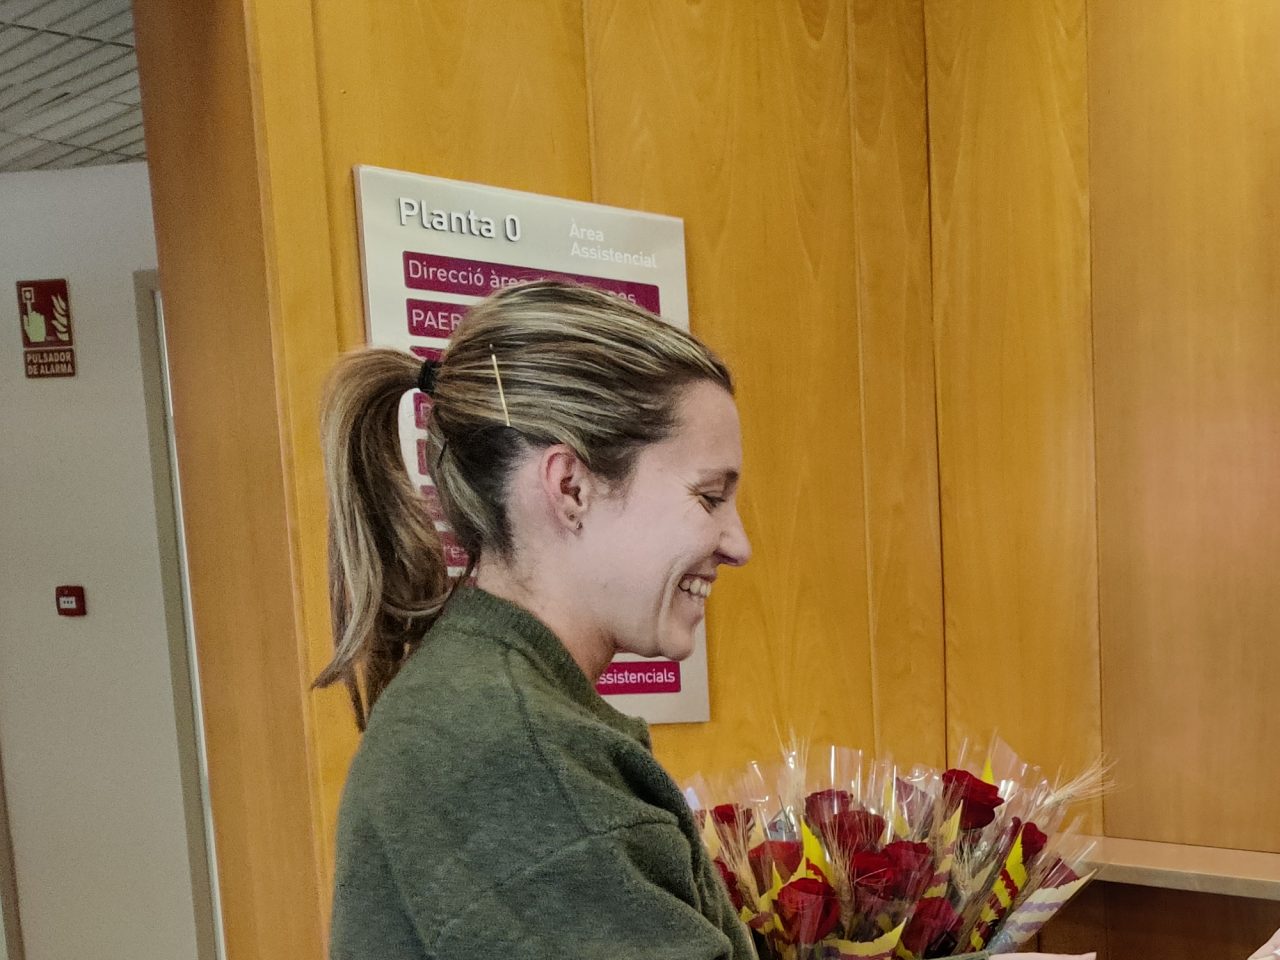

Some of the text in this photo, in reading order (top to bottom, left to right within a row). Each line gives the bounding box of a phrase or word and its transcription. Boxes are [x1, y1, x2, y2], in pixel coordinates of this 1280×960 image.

[398, 197, 522, 242] Planta 0
[570, 242, 657, 269] Assistencial
[408, 259, 484, 287] Direcció
[26, 352, 72, 363] PULSADOR
[28, 363, 73, 375] DE ALARMA
[600, 668, 676, 685] ssistencials
